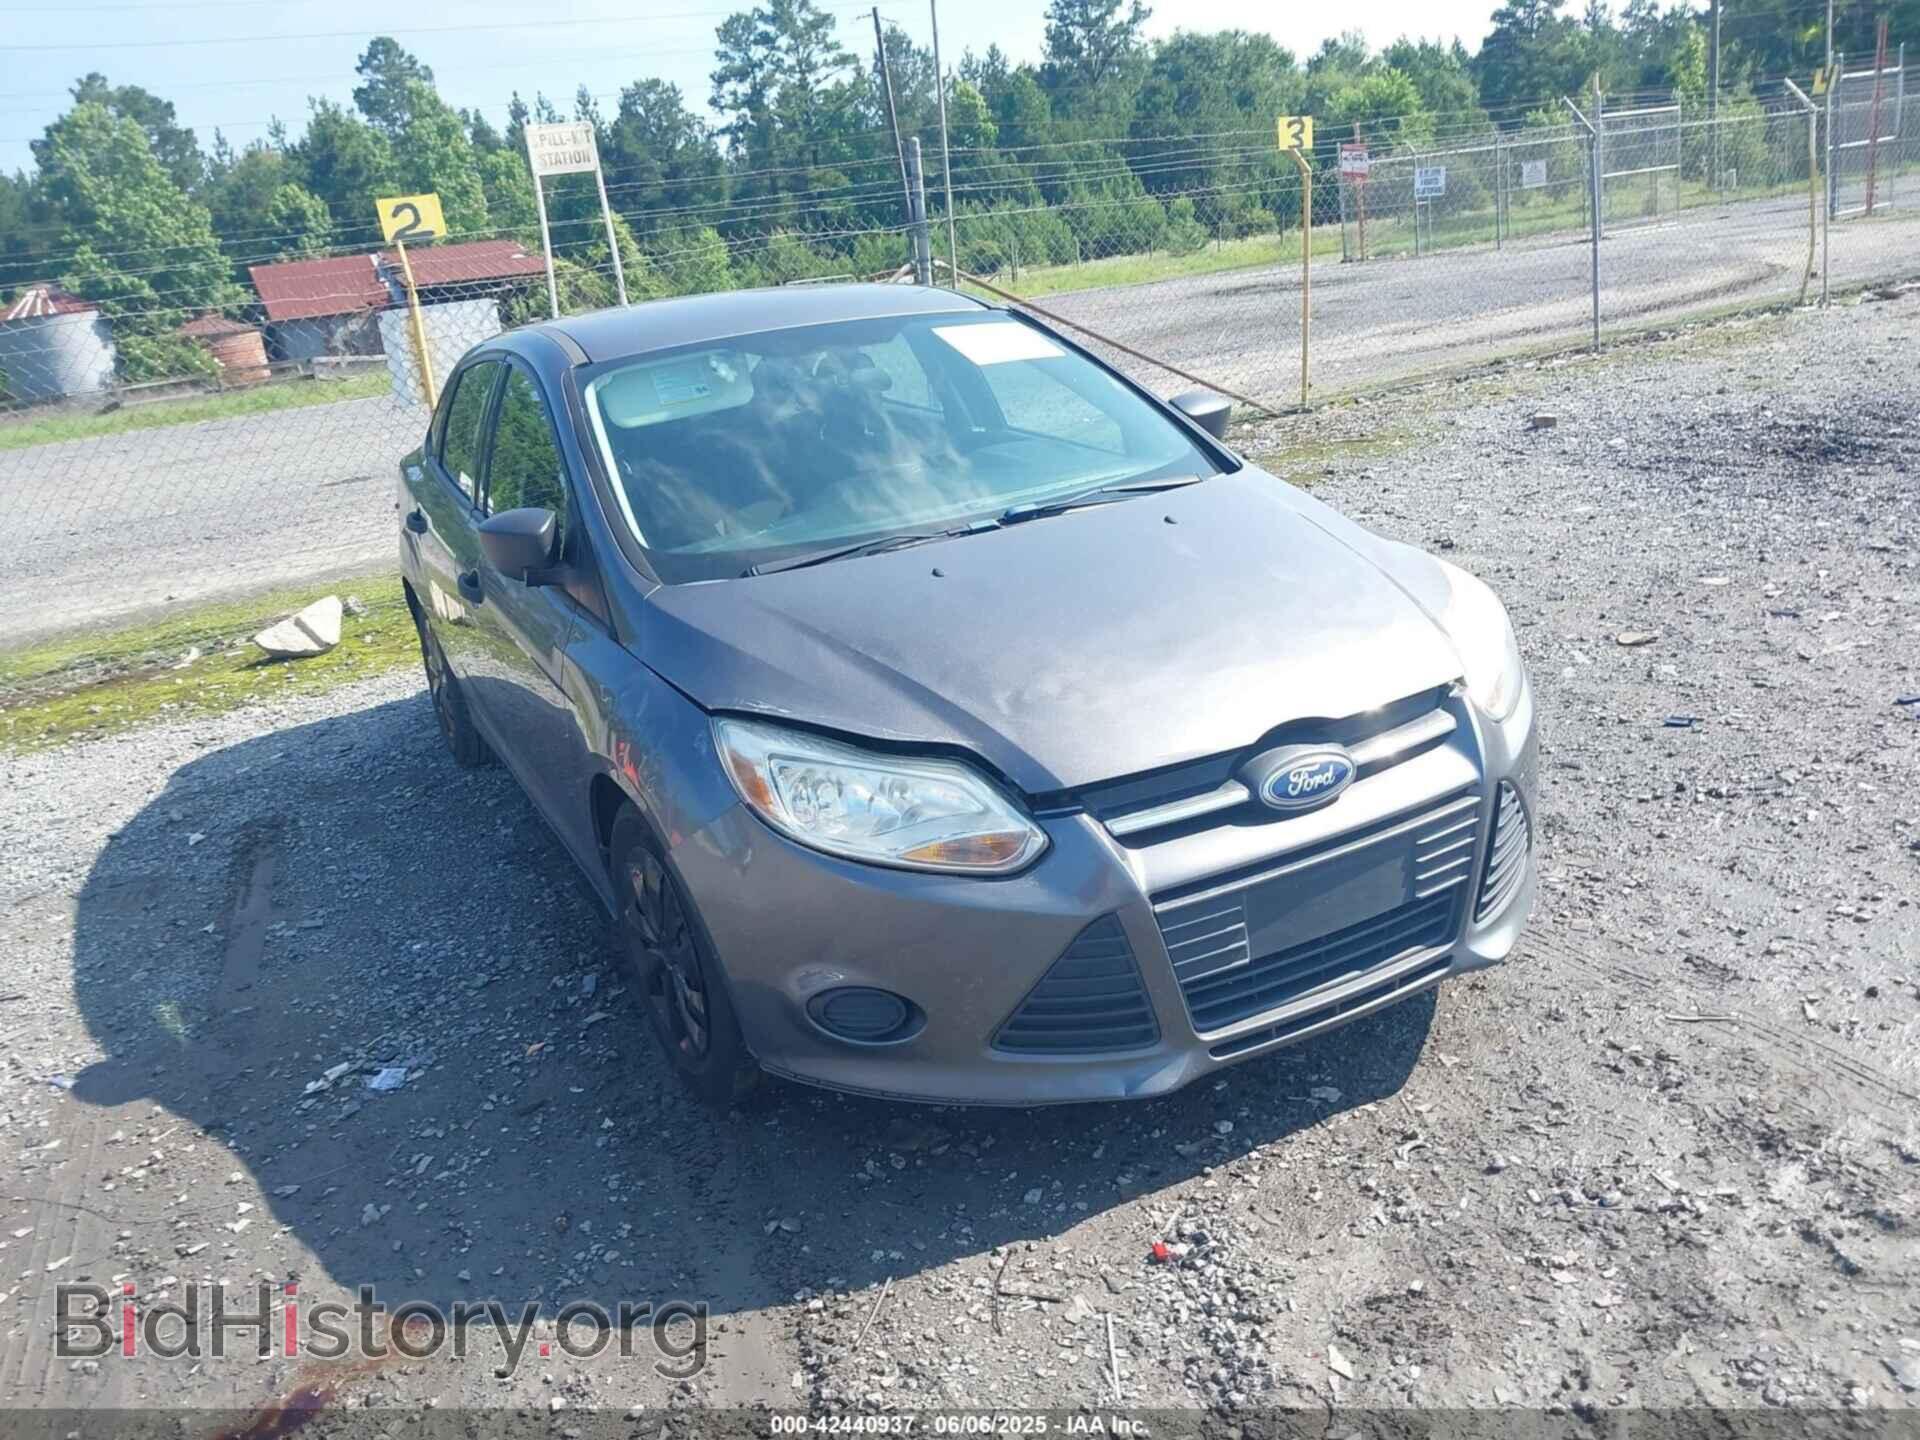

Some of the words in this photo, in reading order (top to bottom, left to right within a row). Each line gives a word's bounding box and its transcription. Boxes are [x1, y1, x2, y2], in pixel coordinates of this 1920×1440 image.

[1286, 117, 1306, 149] 3
[537, 150, 592, 167] STATION
[391, 203, 435, 242] 2
[1288, 763, 1336, 797] Ford
